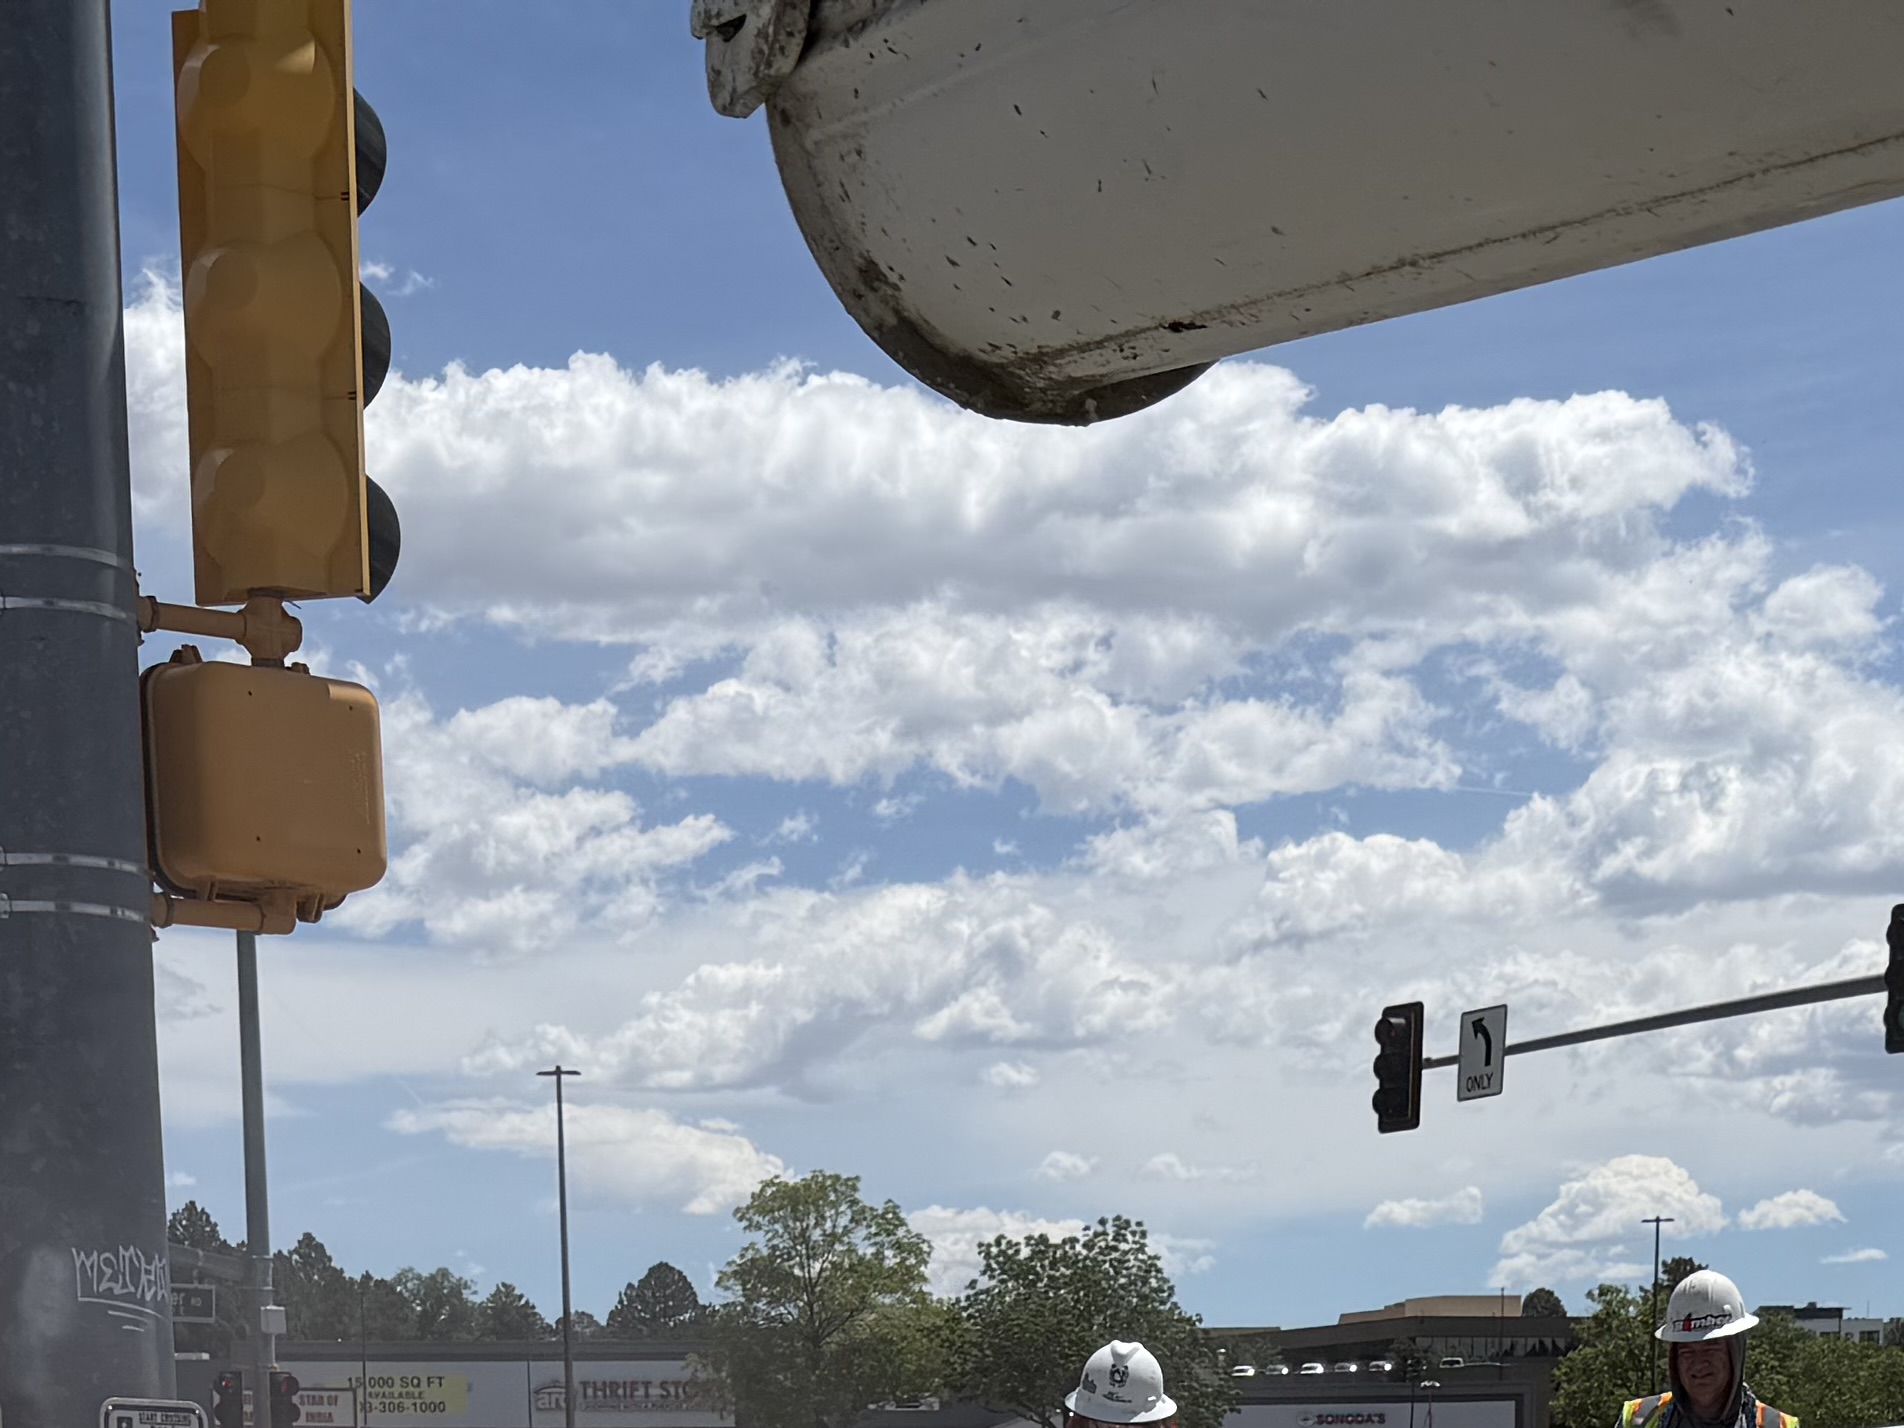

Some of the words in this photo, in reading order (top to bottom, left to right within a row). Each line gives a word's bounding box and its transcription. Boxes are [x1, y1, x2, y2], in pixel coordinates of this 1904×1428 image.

[1466, 1071, 1494, 1093] ONLY
[347, 1375, 395, 1389] 15000
[399, 1375, 422, 1389] SQ
[427, 1375, 445, 1388] FT
[367, 1390, 425, 1400] AVAILABLE
[579, 1380, 652, 1400] THRIFT
[298, 1393, 325, 1406] STAR
[305, 1411, 334, 1423] INDIA
